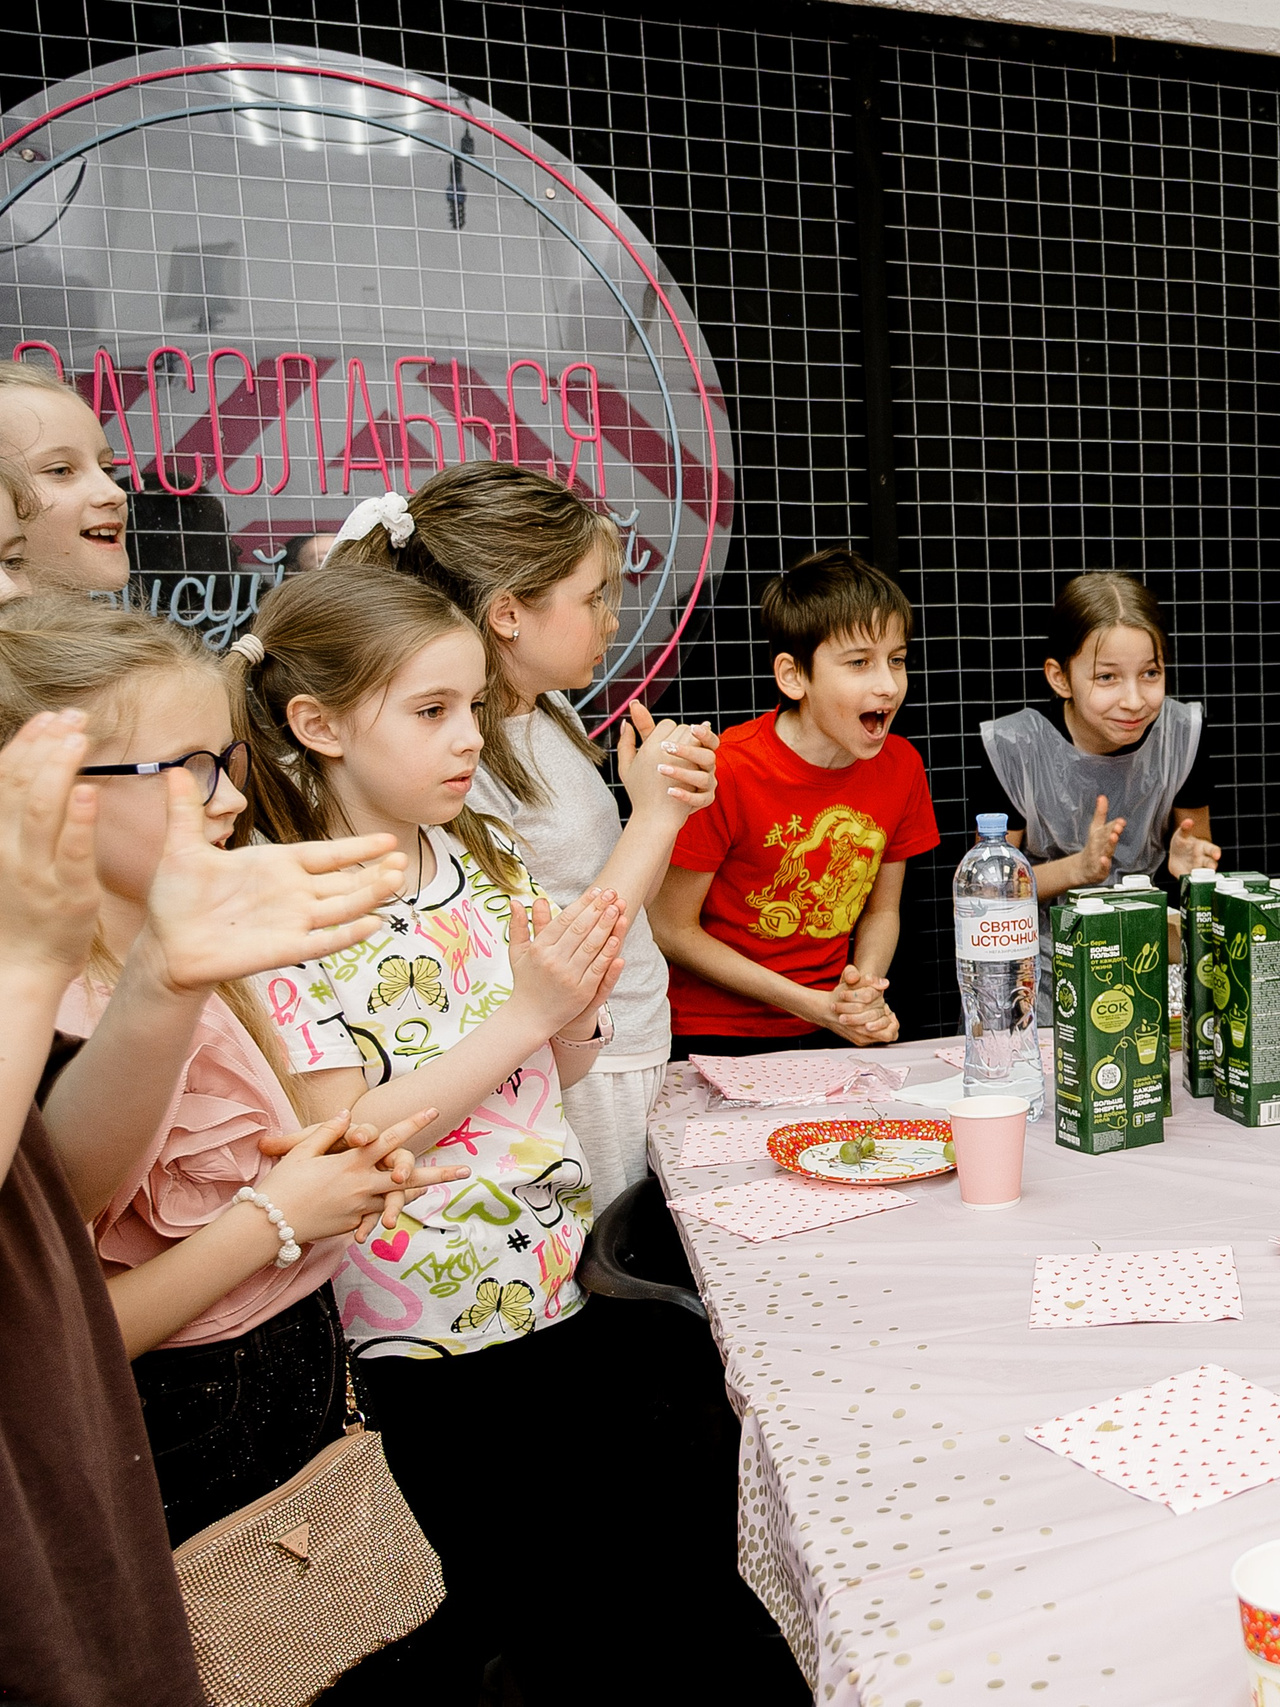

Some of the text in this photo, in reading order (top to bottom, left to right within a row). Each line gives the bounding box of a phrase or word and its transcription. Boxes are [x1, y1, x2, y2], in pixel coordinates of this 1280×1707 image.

[763, 814, 806, 850] 武术
[980, 914, 1034, 933] СВЯТОЙ
[971, 929, 1038, 947] ИСТОЧНИК
[1090, 944, 1120, 954] БОЛЬШЕ
[1090, 951, 1120, 959] ПОЛЬЗЫ
[1100, 956, 1128, 964] каждого
[1096, 1001, 1129, 1015] СОК
[1133, 1083, 1162, 1094] КАЖДЫЙ
[1093, 1097, 1124, 1107] БОЛЬШЕ
[1133, 1093, 1151, 1102] ДЕНЬ
[1133, 1096, 1162, 1108] ДОБРЫМ
[1094, 1103, 1126, 1114] ЭНЕРГИИ
